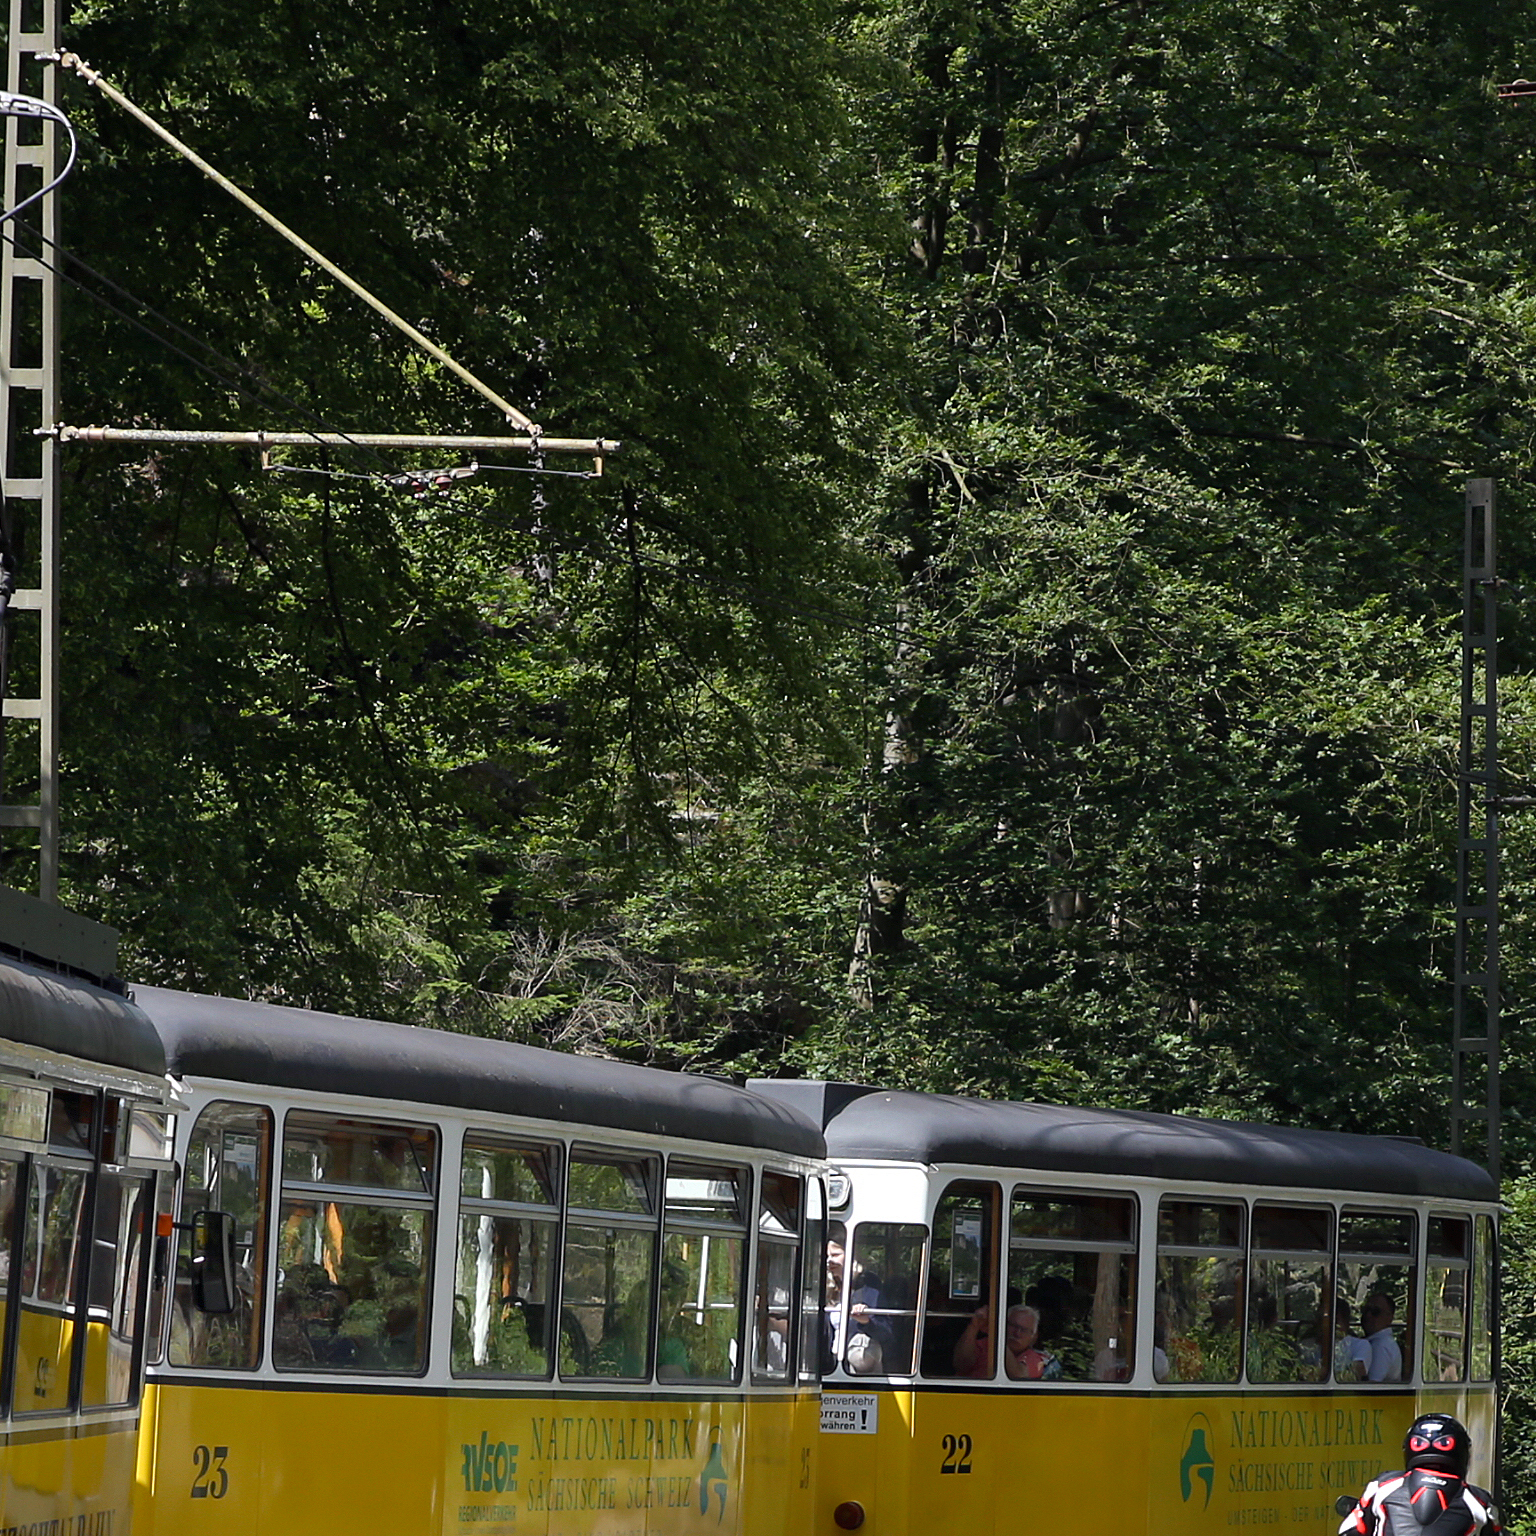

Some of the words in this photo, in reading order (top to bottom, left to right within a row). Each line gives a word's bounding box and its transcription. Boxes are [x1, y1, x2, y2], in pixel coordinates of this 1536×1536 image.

[820, 1396, 875, 1406] enverkehr
[529, 1417, 694, 1461] NATIONALPARK
[1230, 1409, 1384, 1448] NATIONALPARK
[191, 1445, 229, 1498] 23
[940, 1433, 972, 1474] 22
[527, 1471, 617, 1512] SÄCHSISCHE
[626, 1476, 692, 1509] SCHWEIZ
[1228, 1459, 1314, 1492] SÄCHSISCHE
